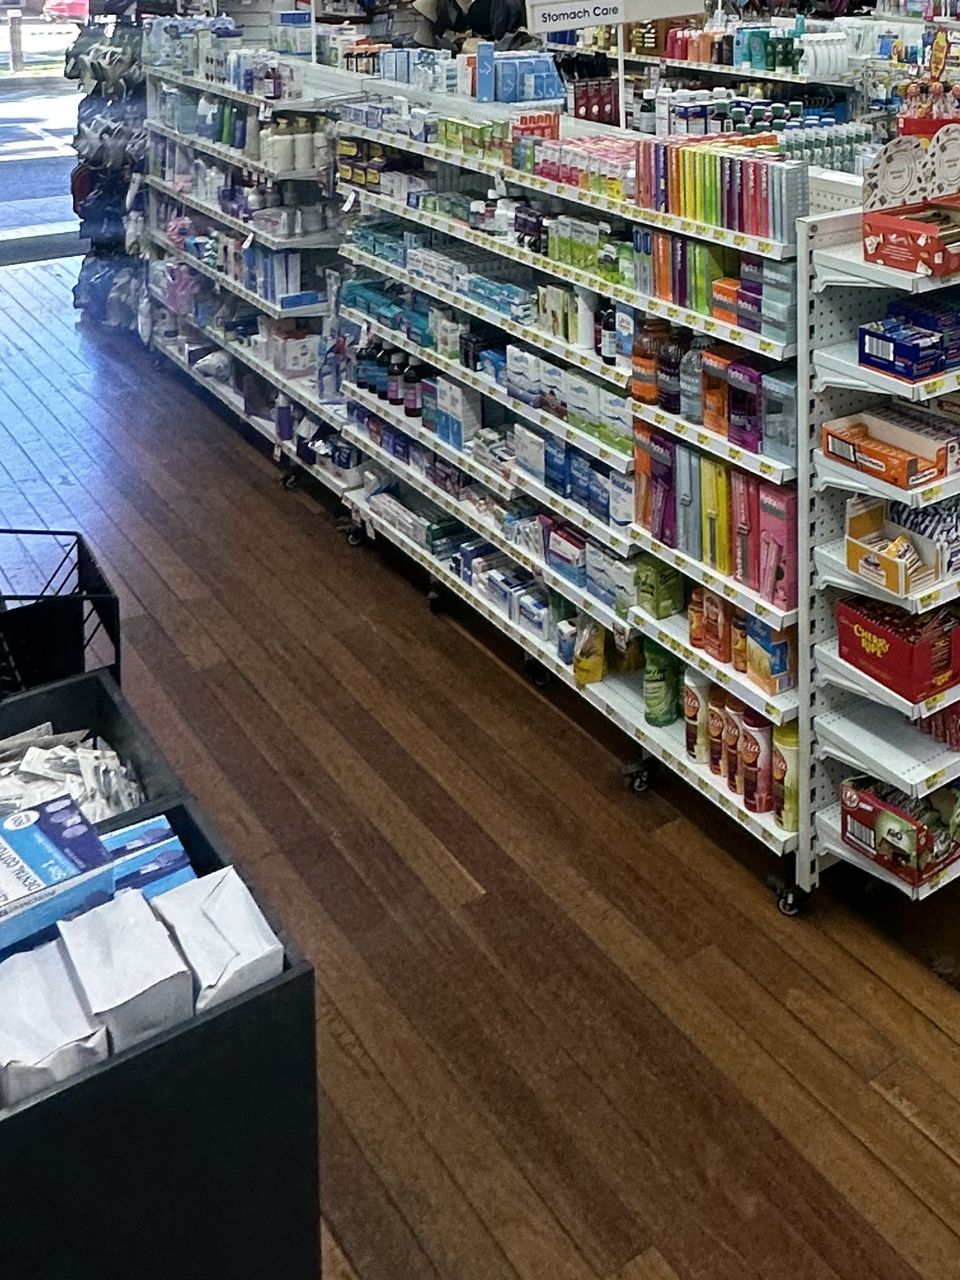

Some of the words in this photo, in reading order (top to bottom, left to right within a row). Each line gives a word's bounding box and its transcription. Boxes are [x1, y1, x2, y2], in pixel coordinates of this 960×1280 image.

[541, 7, 591, 23] Stomach
[592, 5, 619, 17] Care
[12, 865, 42, 892] DENTAL
